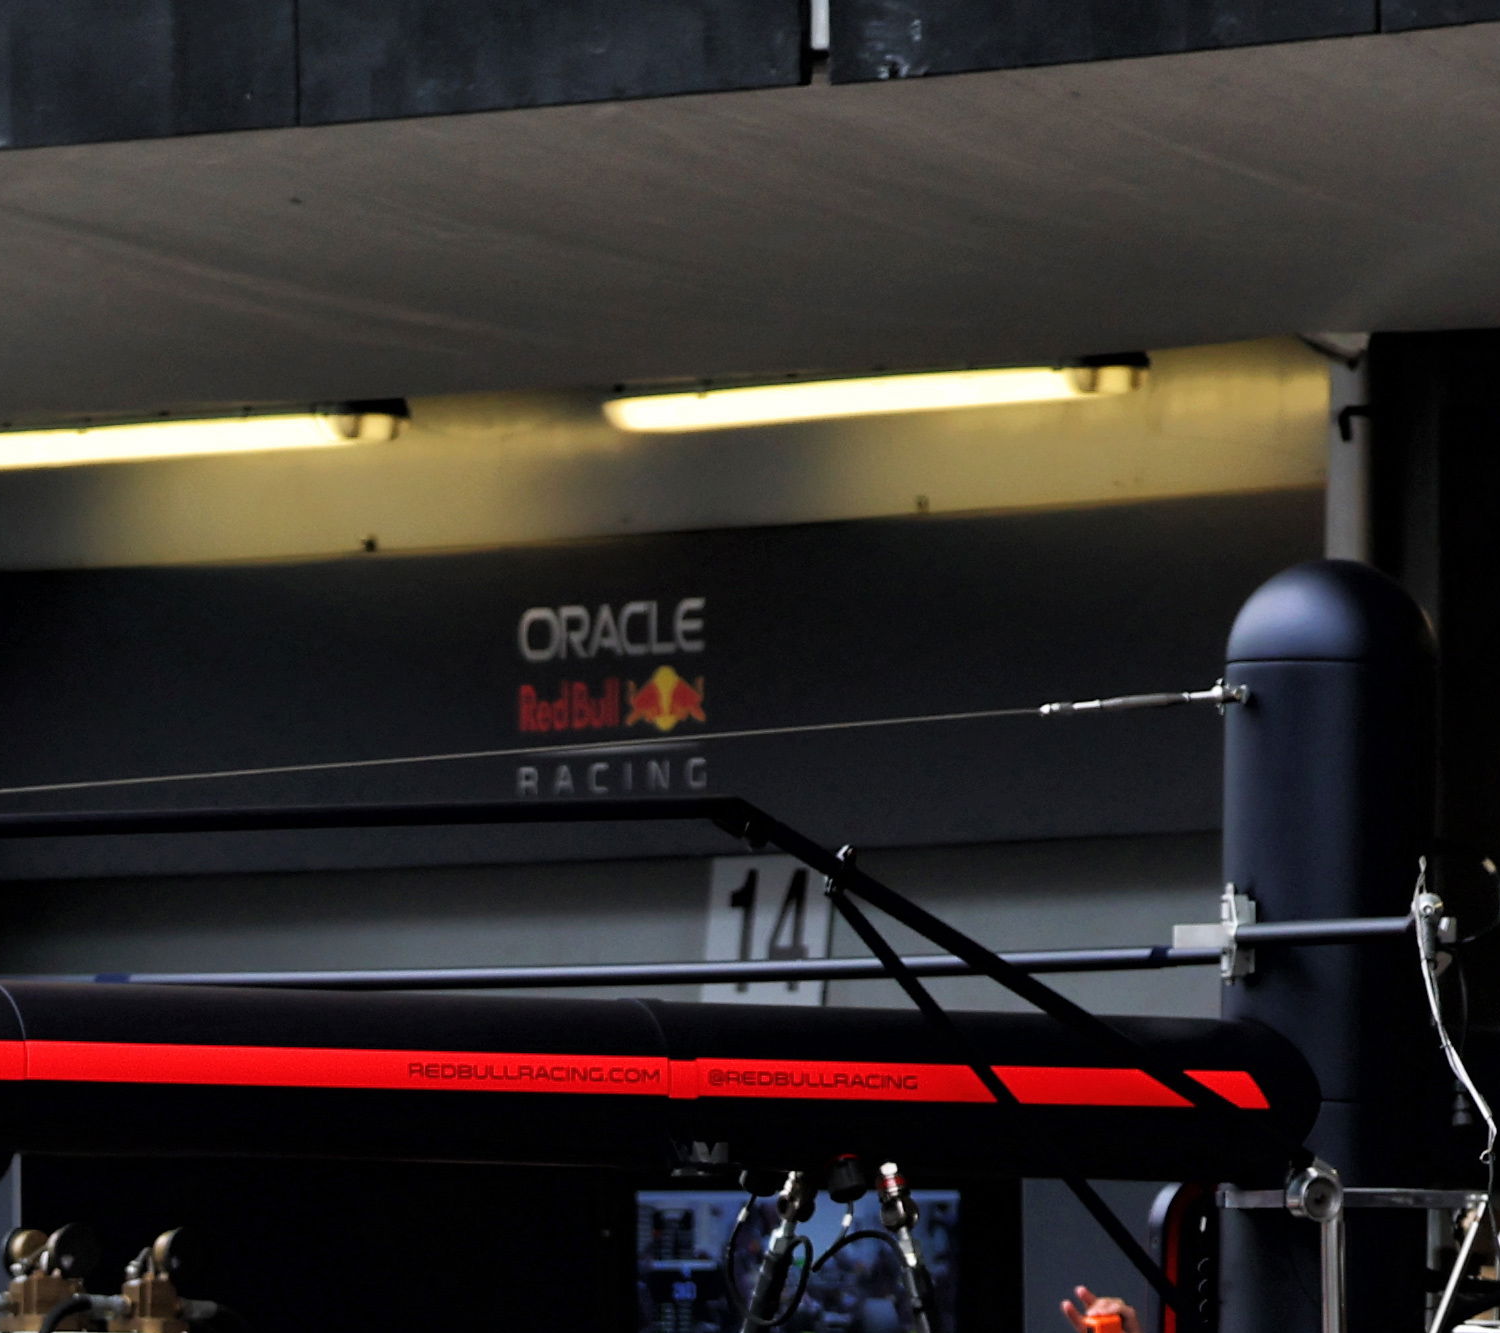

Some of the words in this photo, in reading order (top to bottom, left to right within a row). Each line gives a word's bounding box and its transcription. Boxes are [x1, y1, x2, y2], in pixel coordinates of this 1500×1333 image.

[516, 597, 706, 664] ORACLE
[517, 680, 570, 735] Red
[571, 677, 621, 731] Bull
[514, 755, 707, 797] RACING
[728, 868, 810, 995] 14
[407, 1061, 662, 1087] REDBULLRACING.COM
[706, 1067, 920, 1093] @REDBULLRACING
